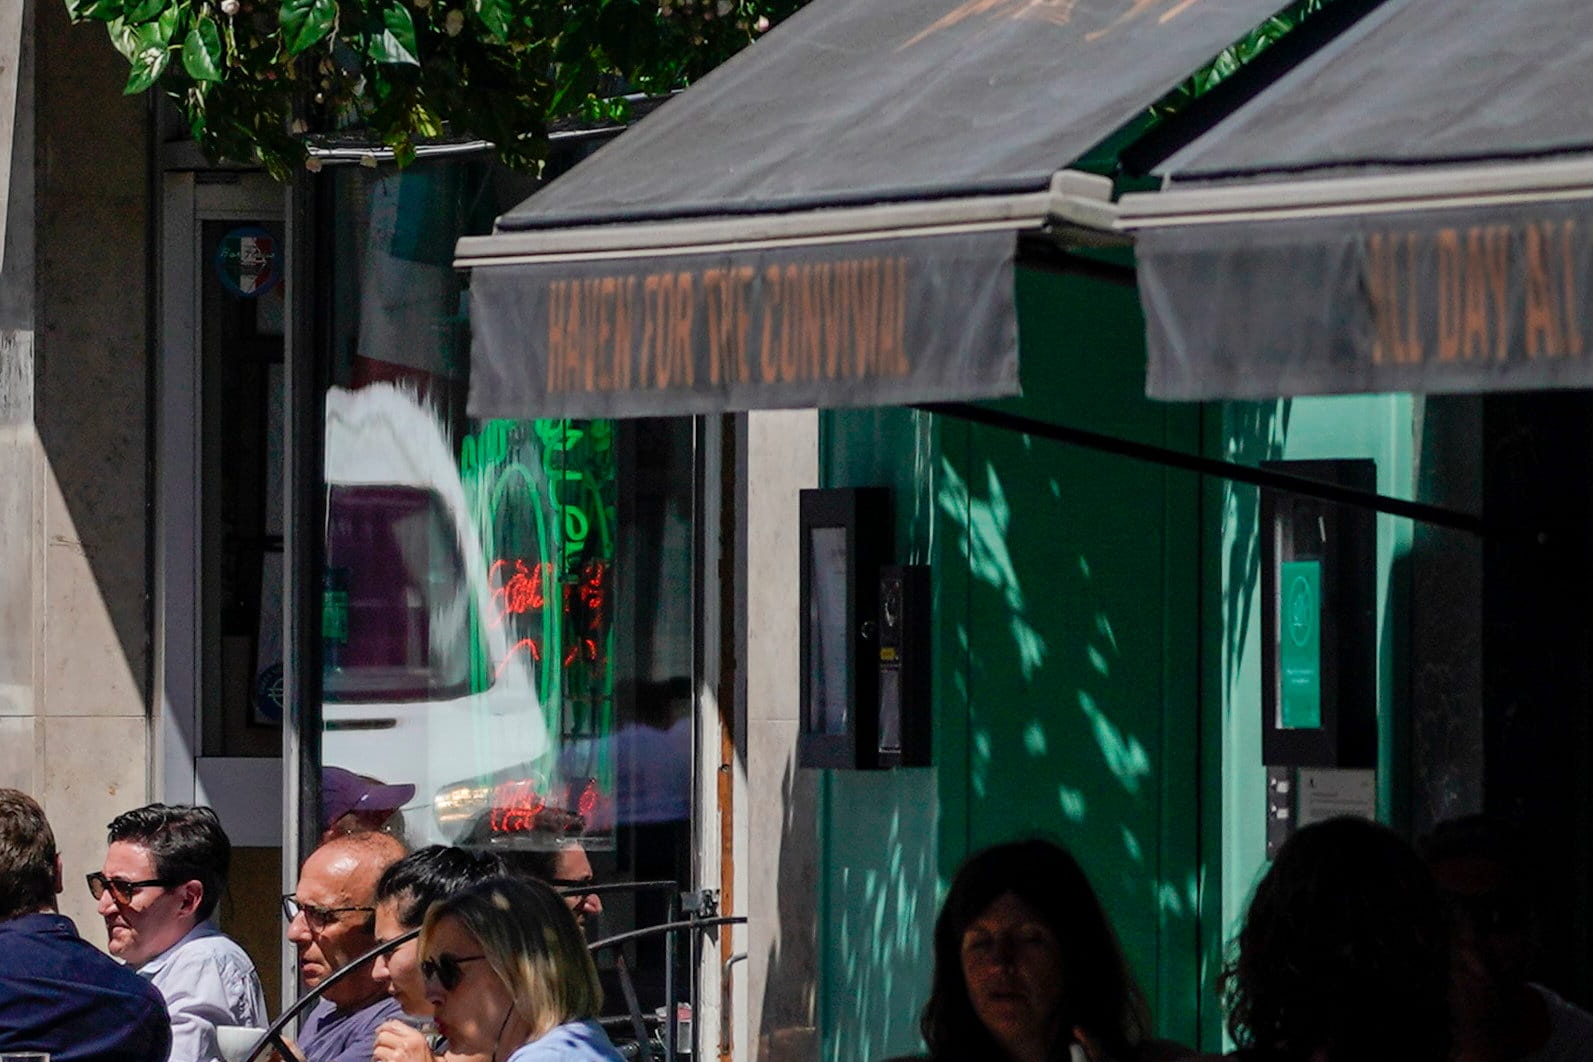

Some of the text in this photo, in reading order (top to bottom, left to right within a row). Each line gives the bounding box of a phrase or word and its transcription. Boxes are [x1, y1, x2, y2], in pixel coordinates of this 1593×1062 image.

[547, 259, 908, 392] HAVEN FOR THE CONVIVIAL
[1438, 228, 1509, 360] DAY
